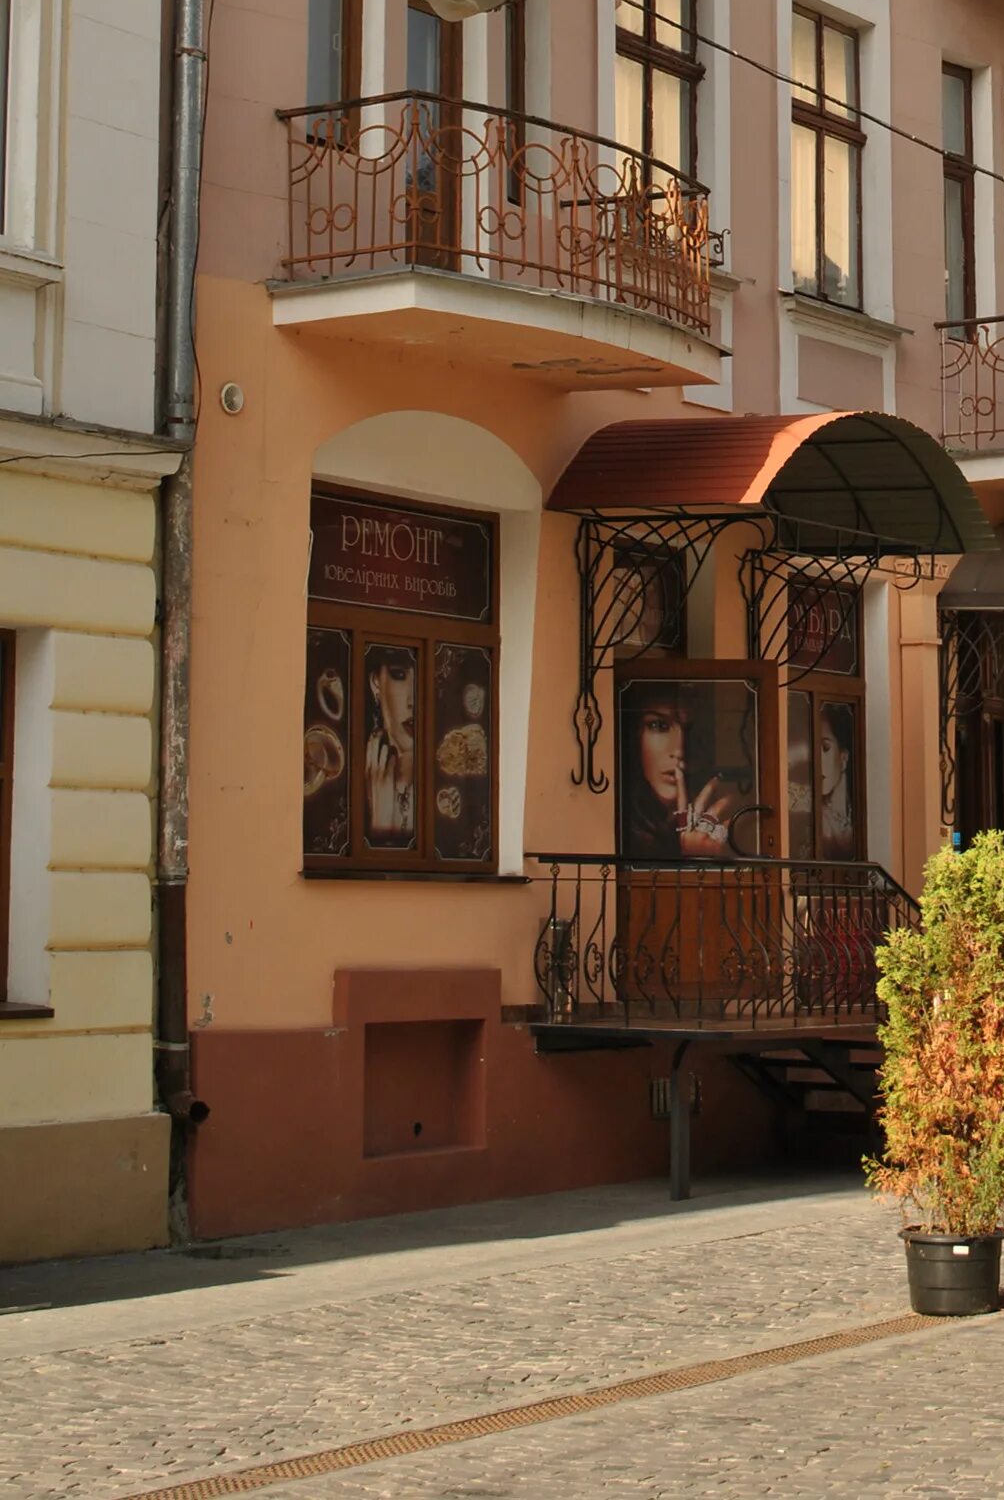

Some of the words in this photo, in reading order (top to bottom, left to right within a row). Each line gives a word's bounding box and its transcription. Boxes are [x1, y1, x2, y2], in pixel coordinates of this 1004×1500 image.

[341, 514, 442, 566] РЕМОНТ
[324, 563, 400, 593] ювелірних
[404, 575, 457, 600] виробів
